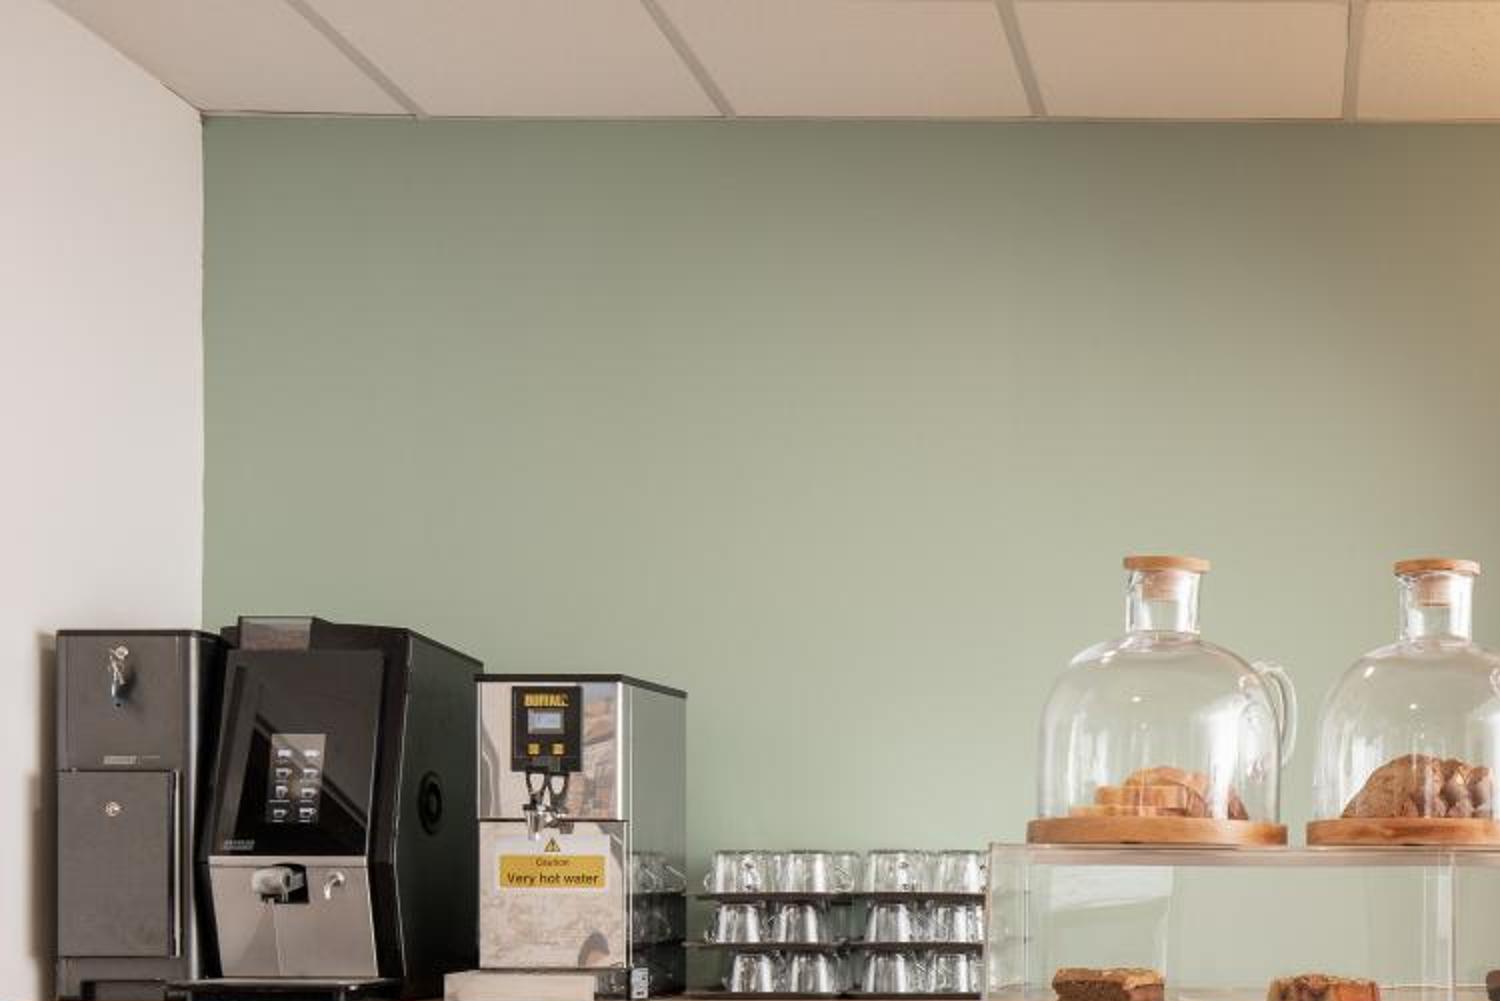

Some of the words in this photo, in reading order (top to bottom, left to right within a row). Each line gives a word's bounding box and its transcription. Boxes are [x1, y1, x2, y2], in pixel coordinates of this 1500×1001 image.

[507, 872, 535, 887] Very
[539, 872, 559, 884] hot
[562, 872, 600, 884] water
